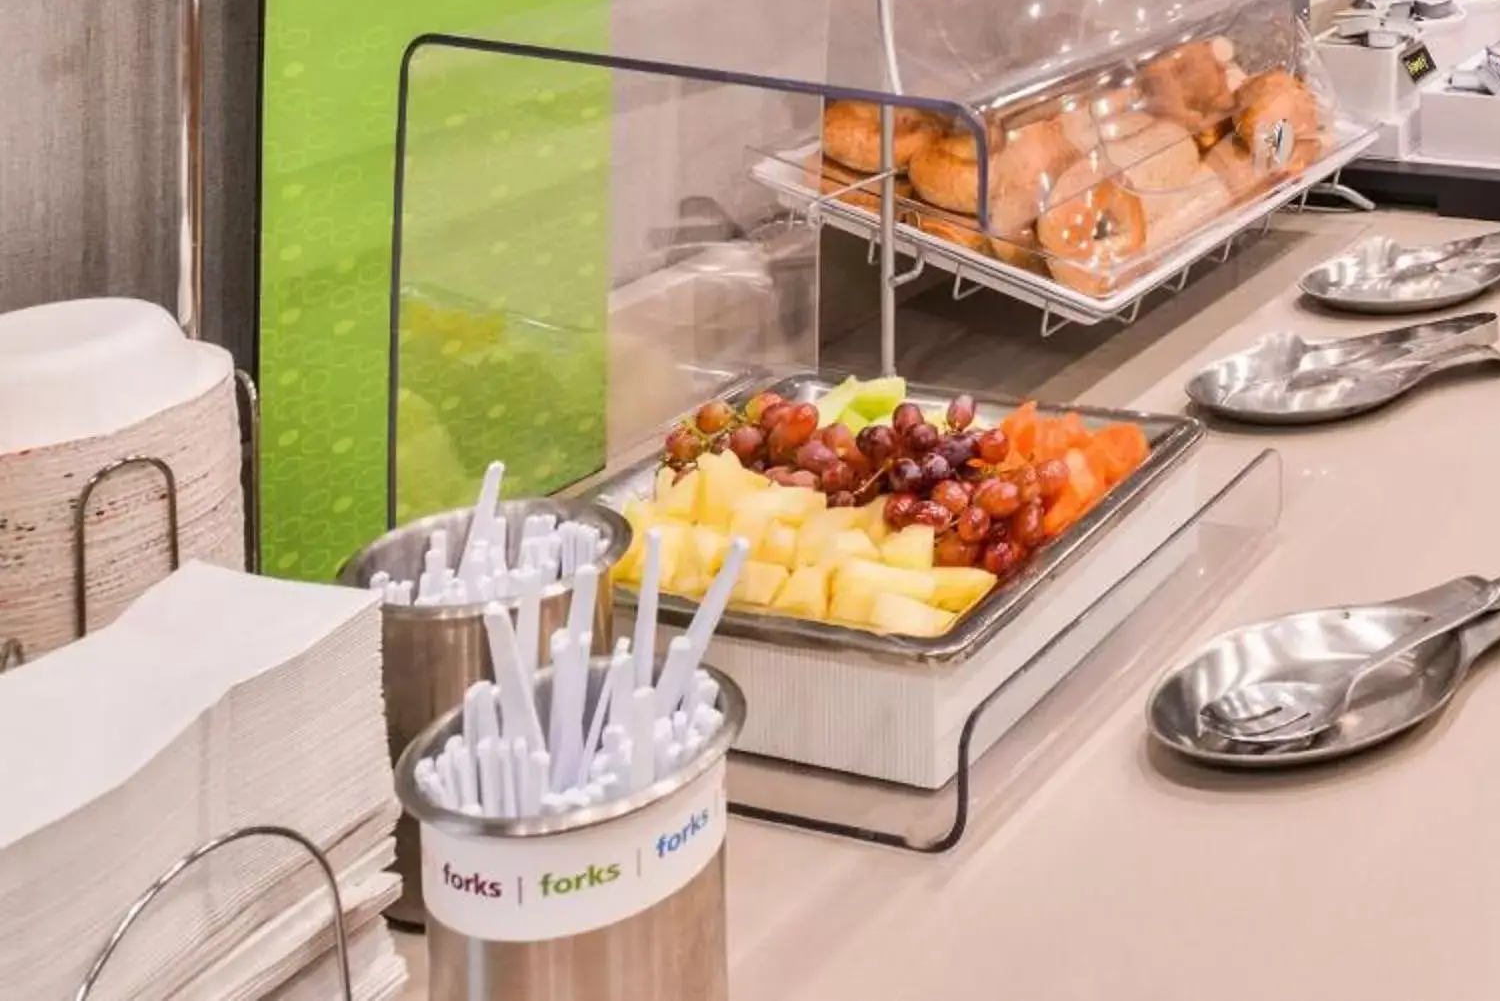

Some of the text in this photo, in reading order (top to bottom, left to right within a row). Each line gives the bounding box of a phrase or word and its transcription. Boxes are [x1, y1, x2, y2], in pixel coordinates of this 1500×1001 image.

[442, 810, 710, 899] forks forks forks
